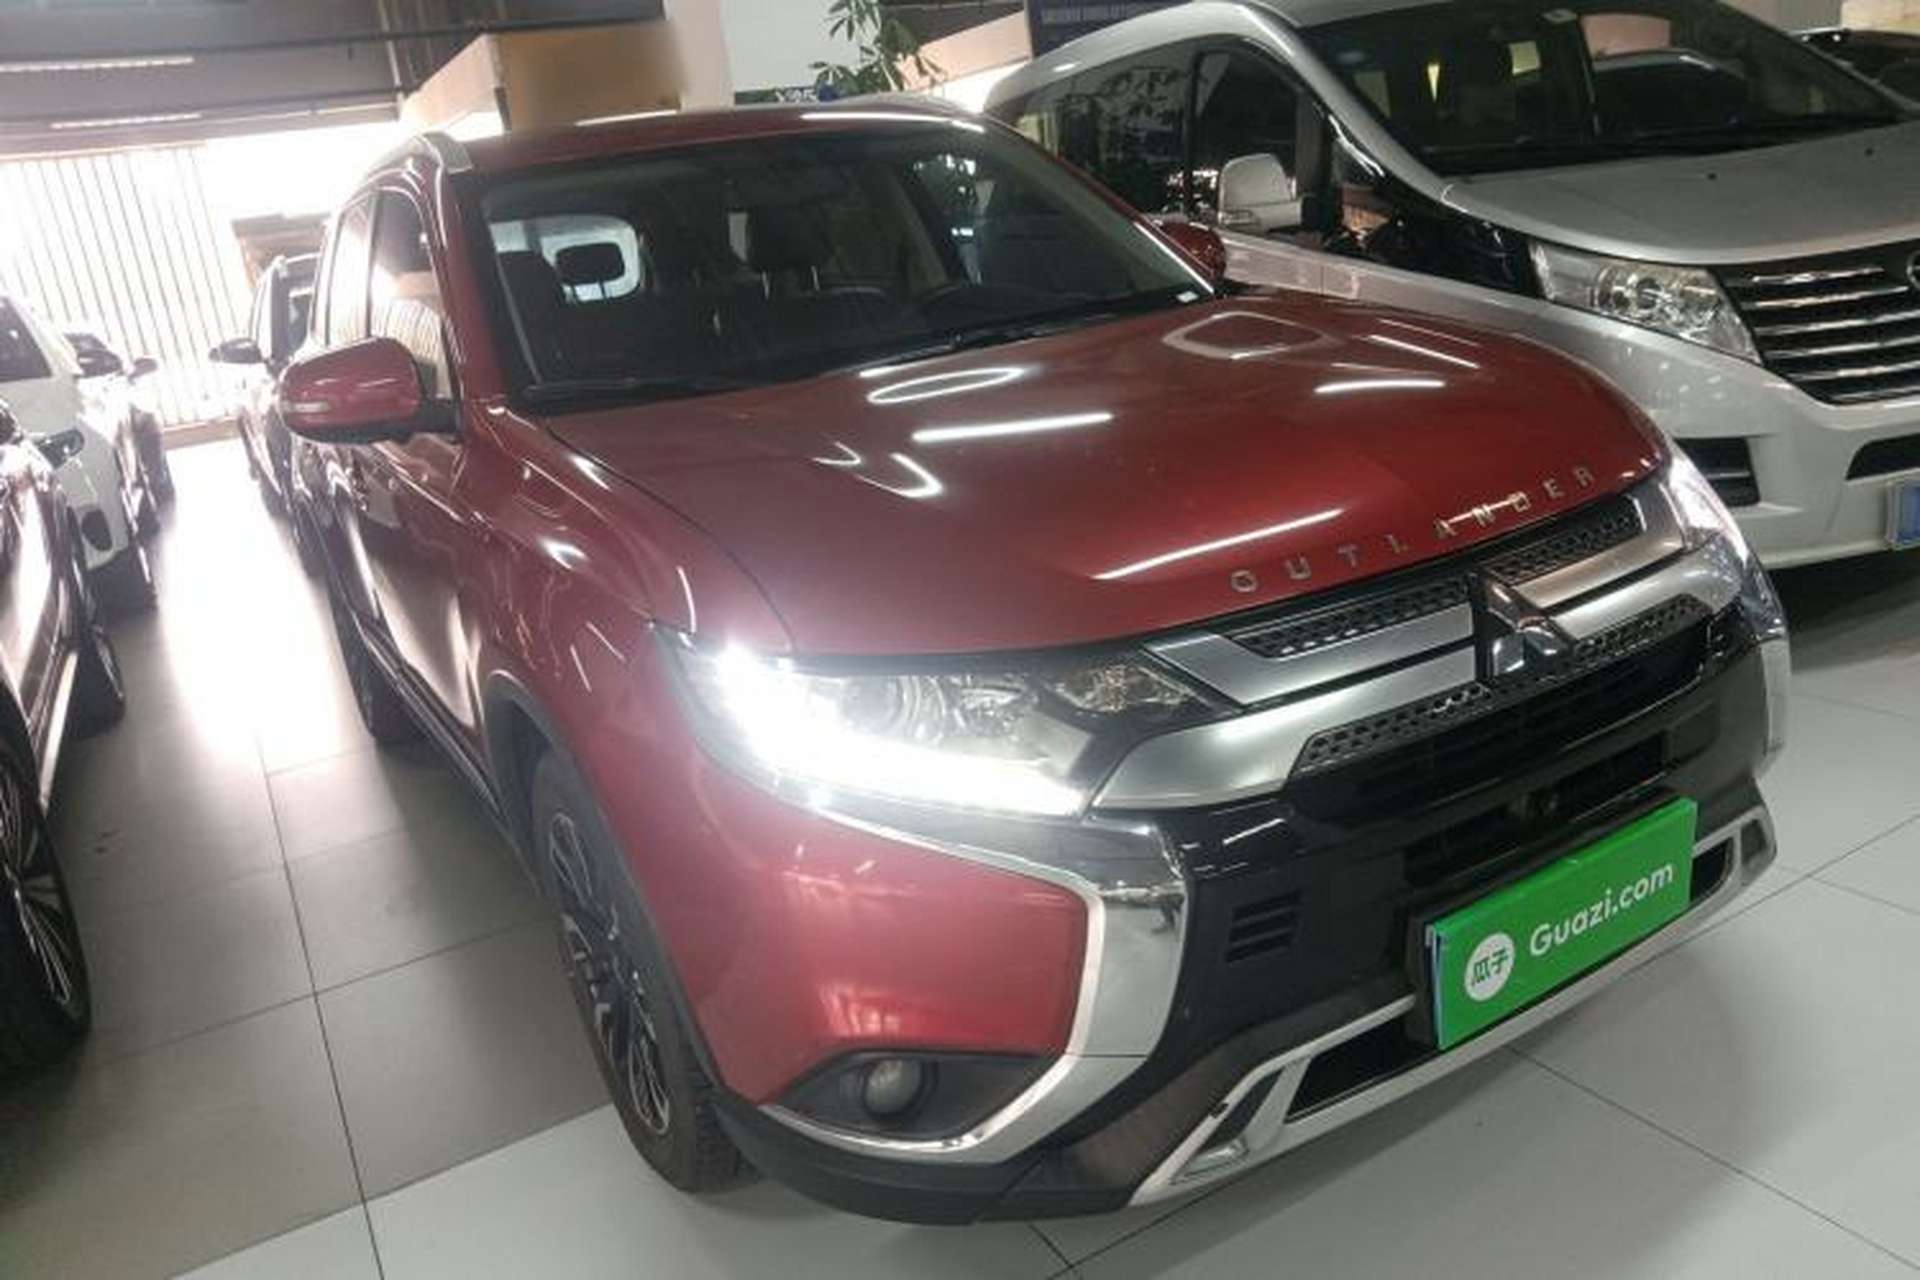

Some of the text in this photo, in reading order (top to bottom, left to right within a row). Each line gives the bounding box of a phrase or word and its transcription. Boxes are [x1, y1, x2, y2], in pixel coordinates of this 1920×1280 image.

[1230, 465, 1594, 593] OUTLANDER
[1529, 863, 1675, 957] Guazi.com
[1470, 947, 1509, 987] 瓜子
